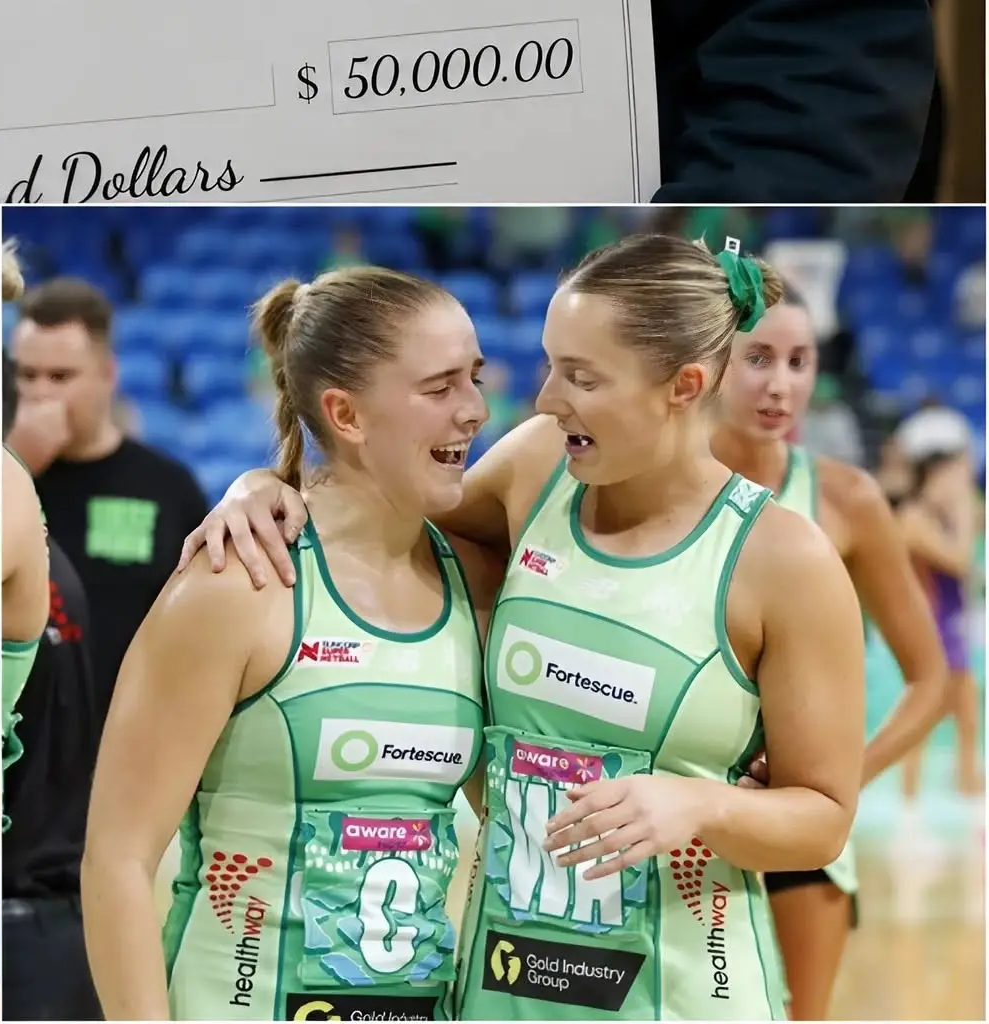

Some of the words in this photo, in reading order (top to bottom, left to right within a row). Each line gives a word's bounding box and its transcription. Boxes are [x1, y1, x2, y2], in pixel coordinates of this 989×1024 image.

[297, 62, 319, 104] $
[344, 37, 574, 99] 50,000.00
[62, 144, 244, 203] Dollars
[345, 823, 407, 840] aware
[360, 856, 421, 974] C
[707, 881, 731, 1000] healthway
[229, 895, 271, 1007] healthway
[526, 954, 559, 973] Gold
[563, 959, 625, 984] Industry
[527, 971, 570, 991] Group
